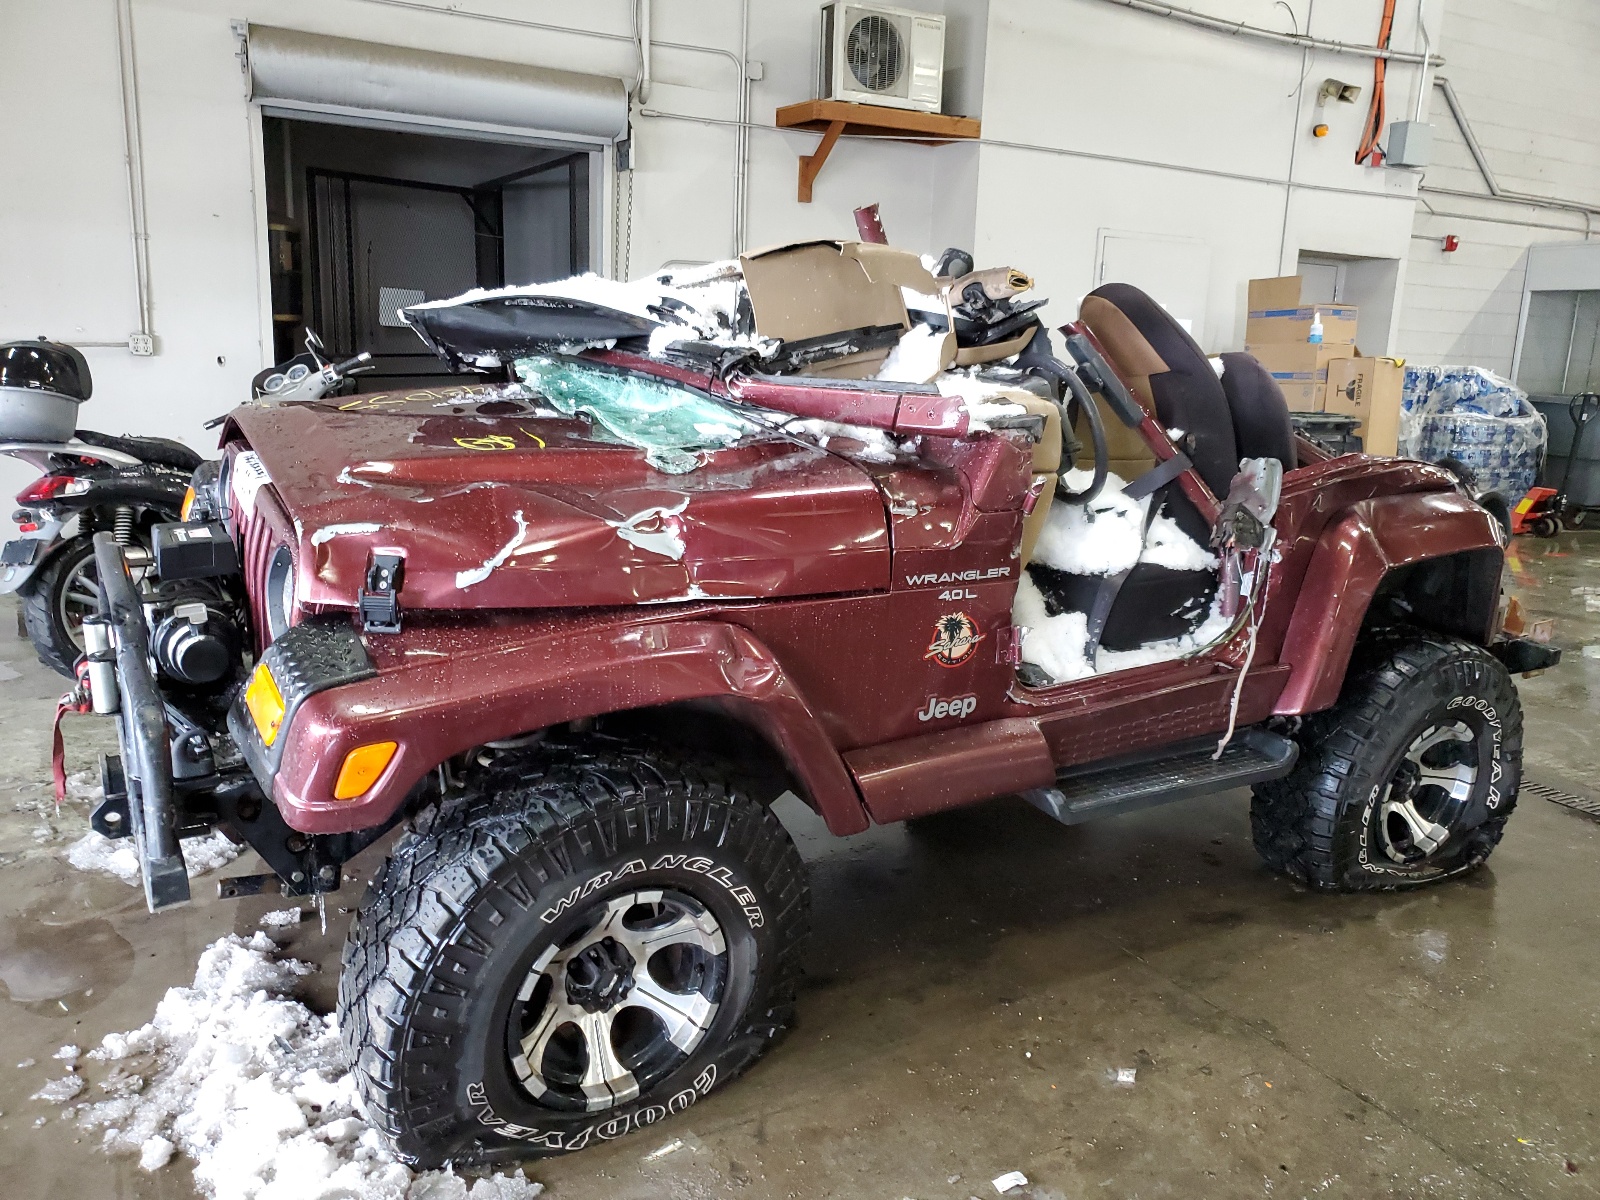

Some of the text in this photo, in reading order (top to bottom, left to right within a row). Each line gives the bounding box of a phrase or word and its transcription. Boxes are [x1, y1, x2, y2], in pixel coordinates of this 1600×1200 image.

[1354, 373, 1364, 407] FRAGILE
[905, 566, 1011, 586] WRANGLER
[924, 633, 987, 660] Sahara
[937, 648, 973, 664] EDITION
[918, 695, 977, 722] Jeep
[1446, 695, 1503, 810] GOODYEAR
[539, 854, 765, 930] WRANGLER
[465, 1063, 717, 1151] GOODYEAR
